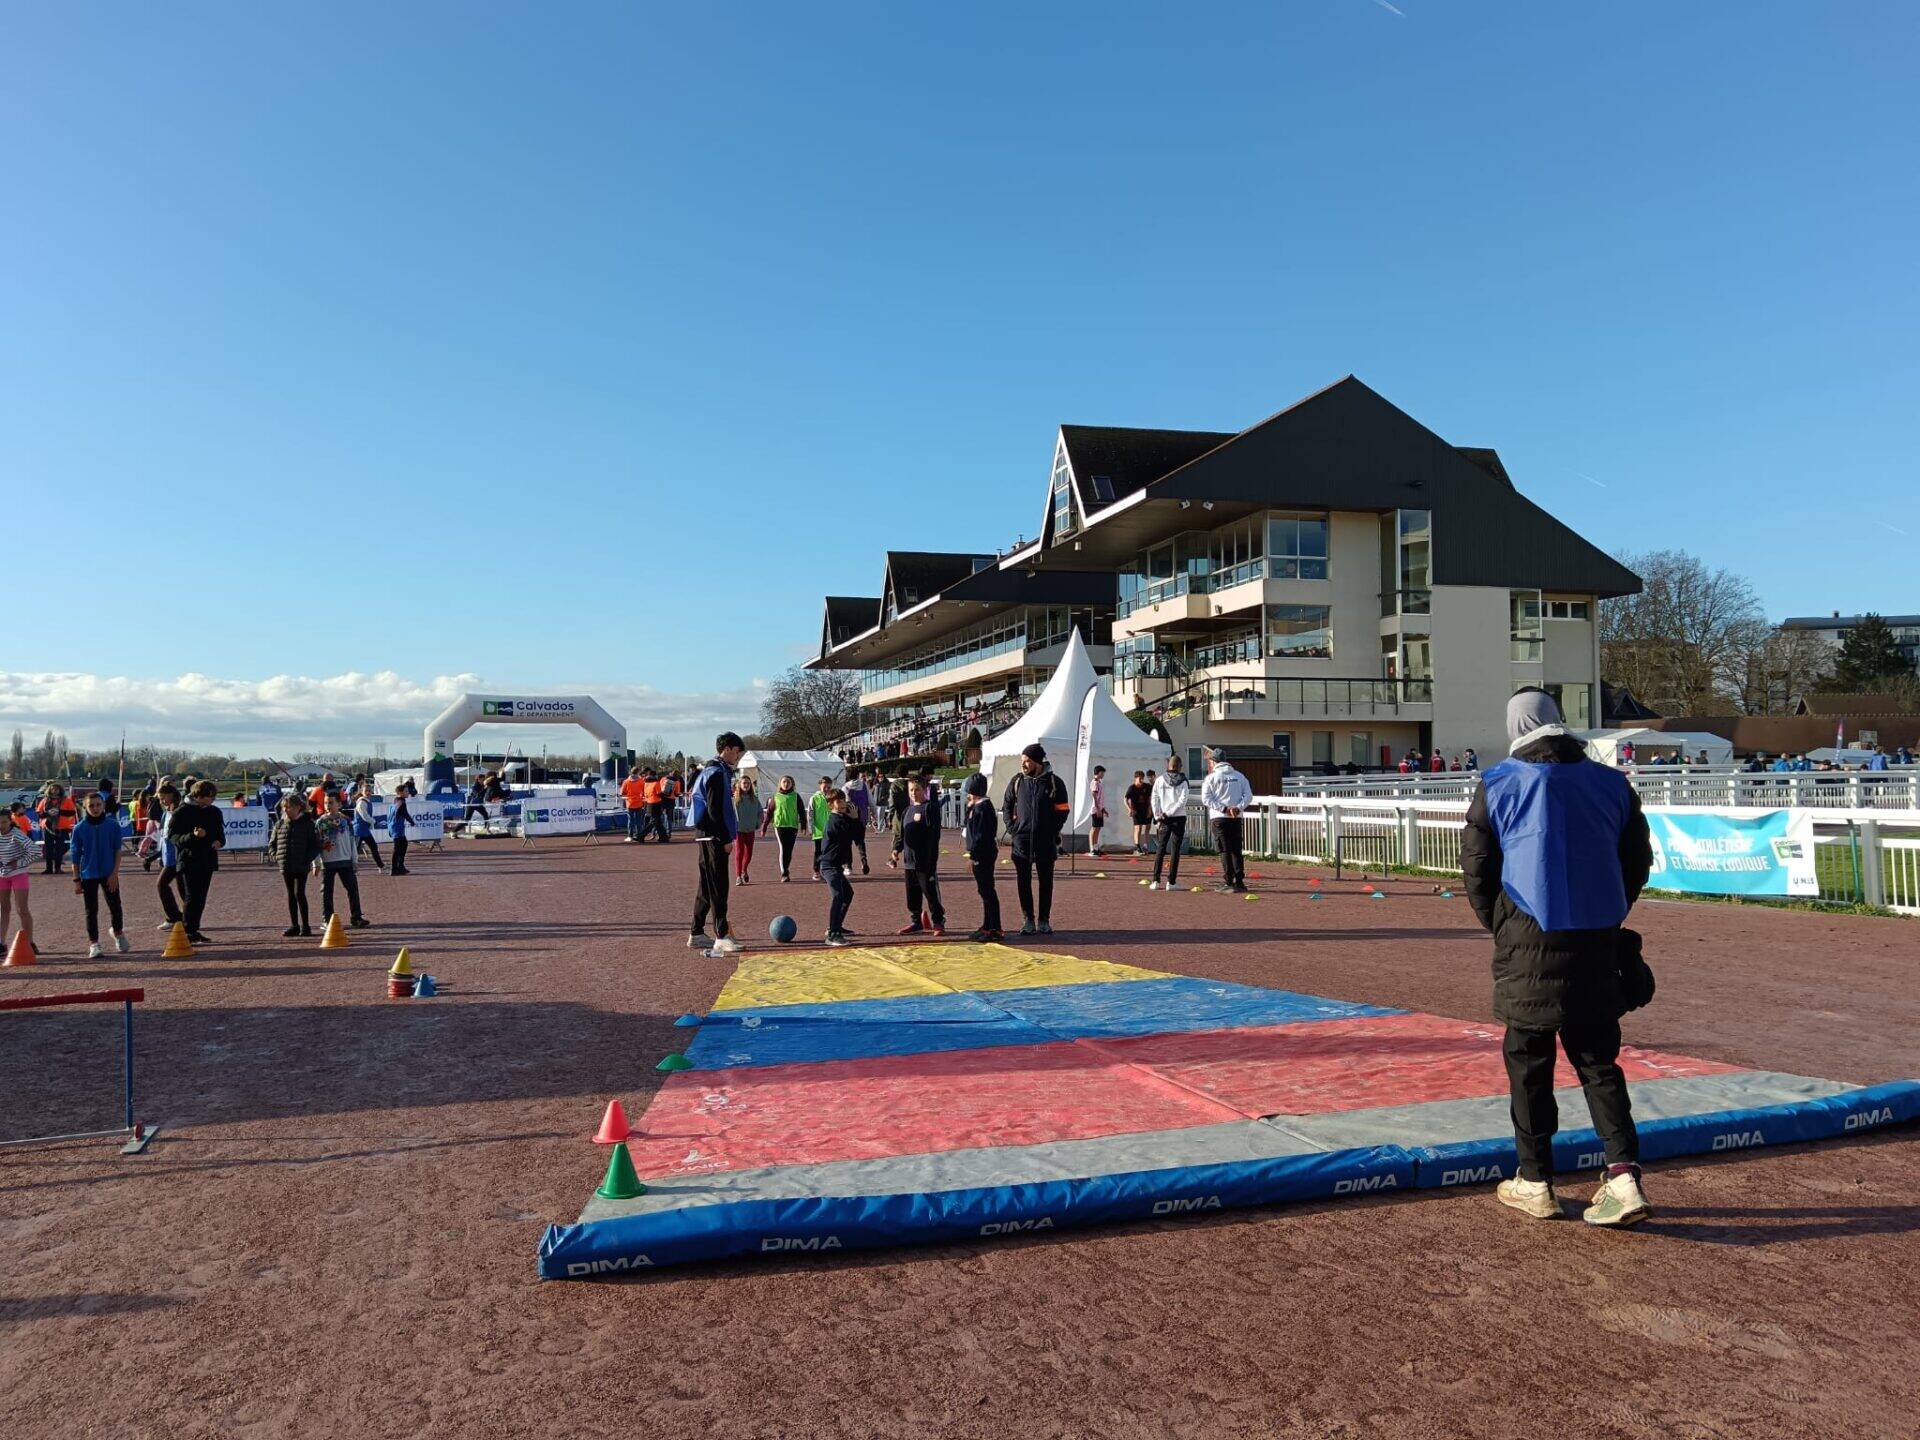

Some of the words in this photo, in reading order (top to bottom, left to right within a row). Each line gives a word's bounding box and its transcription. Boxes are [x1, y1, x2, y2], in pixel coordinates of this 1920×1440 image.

[516, 701, 574, 711] Calvados
[551, 807, 595, 816] Calvados
[223, 819, 264, 829] vados
[1670, 856, 1681, 870] ET
[1723, 855, 1771, 872] LUDIQUE
[1843, 1107, 1894, 1130] DIMA
[1712, 1130, 1765, 1150] DIMA
[1333, 1174, 1397, 1194] DIMA
[1441, 1164, 1503, 1186] DIMA
[1152, 1195, 1222, 1214] DIMA
[979, 1217, 1054, 1236] DIMA
[761, 1236, 843, 1251] DIMA
[567, 1254, 655, 1276] DIMA
